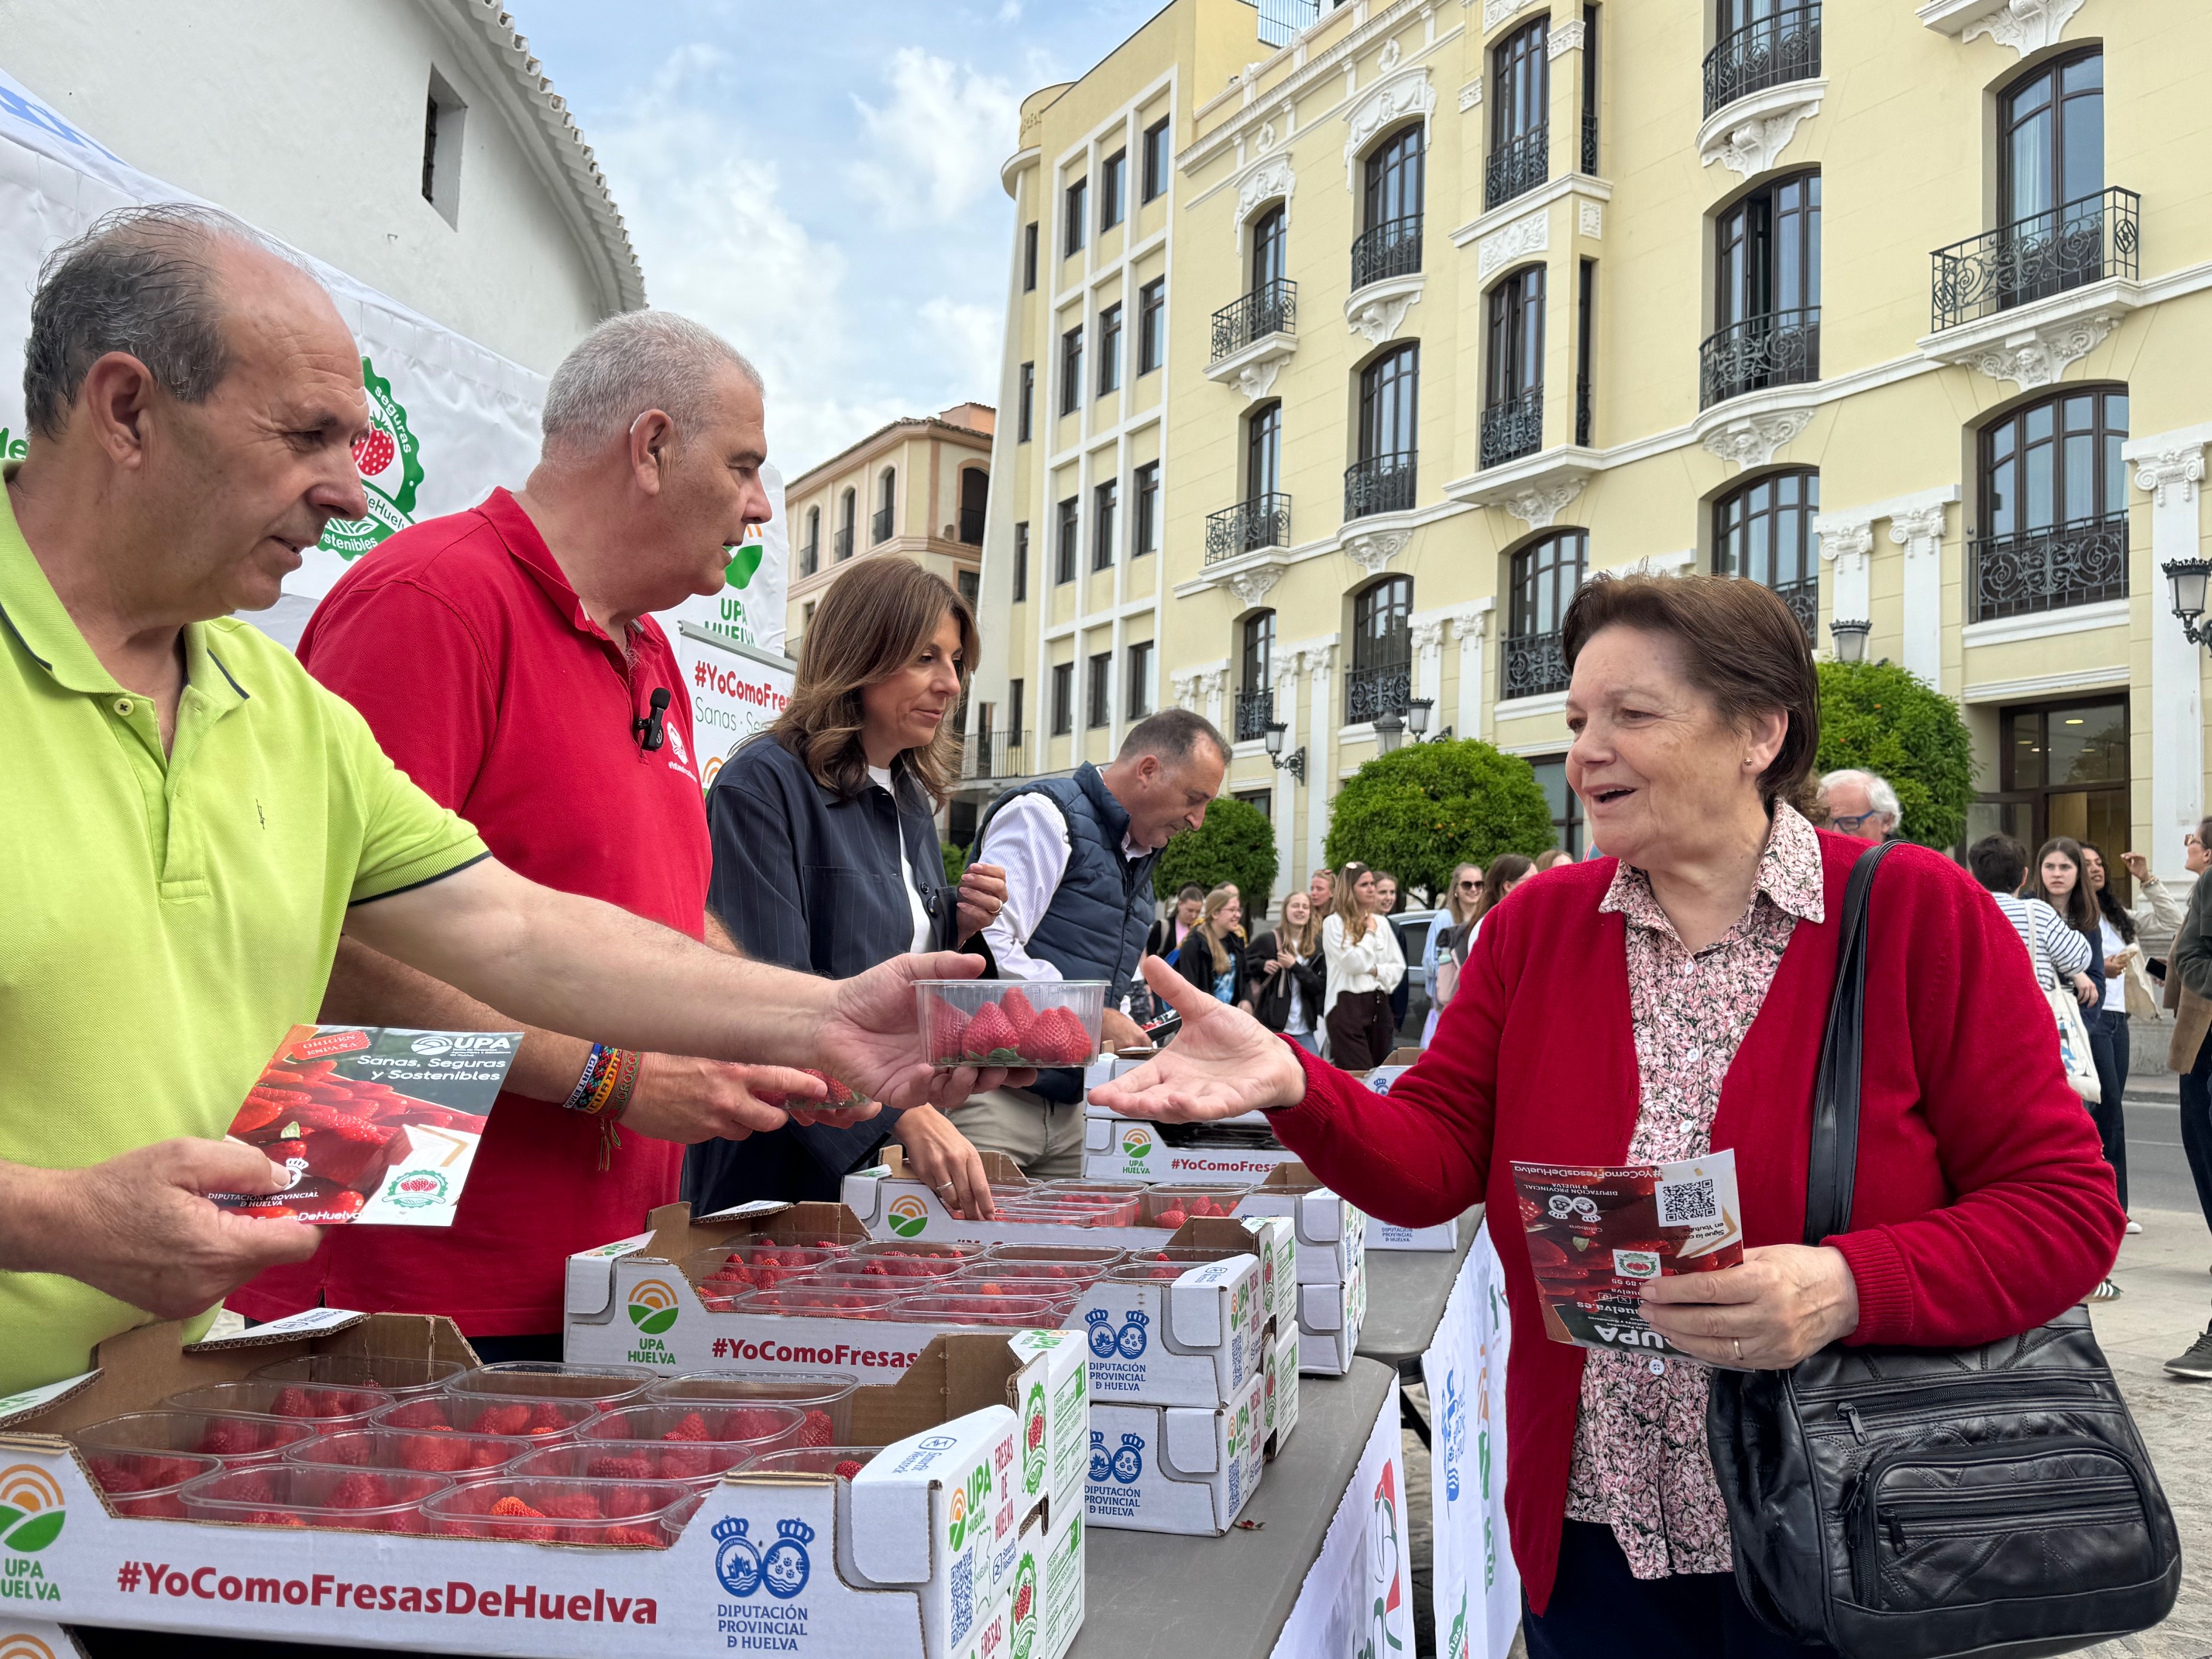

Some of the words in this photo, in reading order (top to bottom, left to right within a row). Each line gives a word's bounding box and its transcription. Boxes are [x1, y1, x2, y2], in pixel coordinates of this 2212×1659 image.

[375, 386, 411, 454] seguras
[720, 597, 748, 627] UPA
[696, 696, 737, 731] Sanas
[454, 1037, 511, 1049] UPA
[357, 1055, 421, 1069] Sanas,
[428, 1058, 507, 1070] Seguras
[371, 1071, 384, 1080] y
[388, 1069, 501, 1081] Sostenibles
[1514, 1166, 1663, 1178] #YoComoFresasDeHuelva
[1523, 1183, 1569, 1194] PROVINCIAL
[1705, 1229, 1725, 1238] Sigue
[1594, 1324, 1665, 1349] UPA
[639, 1338, 665, 1352] UPA
[627, 1350, 677, 1365] HUELVA
[1089, 1362, 1146, 1373] DIPUTACIÓN
[1090, 1372, 1146, 1382] PROVINCIAL
[1104, 1382, 1140, 1392] HUELVA
[1235, 1401, 1249, 1437] UPA
[994, 1433, 1014, 1477] FRESAS
[967, 1457, 992, 1516] UPA
[1001, 1472, 1008, 1503] DE
[1085, 1485, 1141, 1498] DIPUTACIÓN
[1085, 1495, 1140, 1508] PROVINCIAL
[1097, 1506, 1135, 1517] HUELVA
[994, 1498, 1015, 1544] HUELVA
[5, 1558, 45, 1579] UPA
[117, 1560, 658, 1625] #YoComoFresasDeHuelva
[717, 1603, 809, 1621] DIPUTACIÓN
[717, 1620, 808, 1637] PROVINCIAL
[741, 1636, 799, 1651] HUELVA
[981, 1614, 1001, 1659] FRESAS
